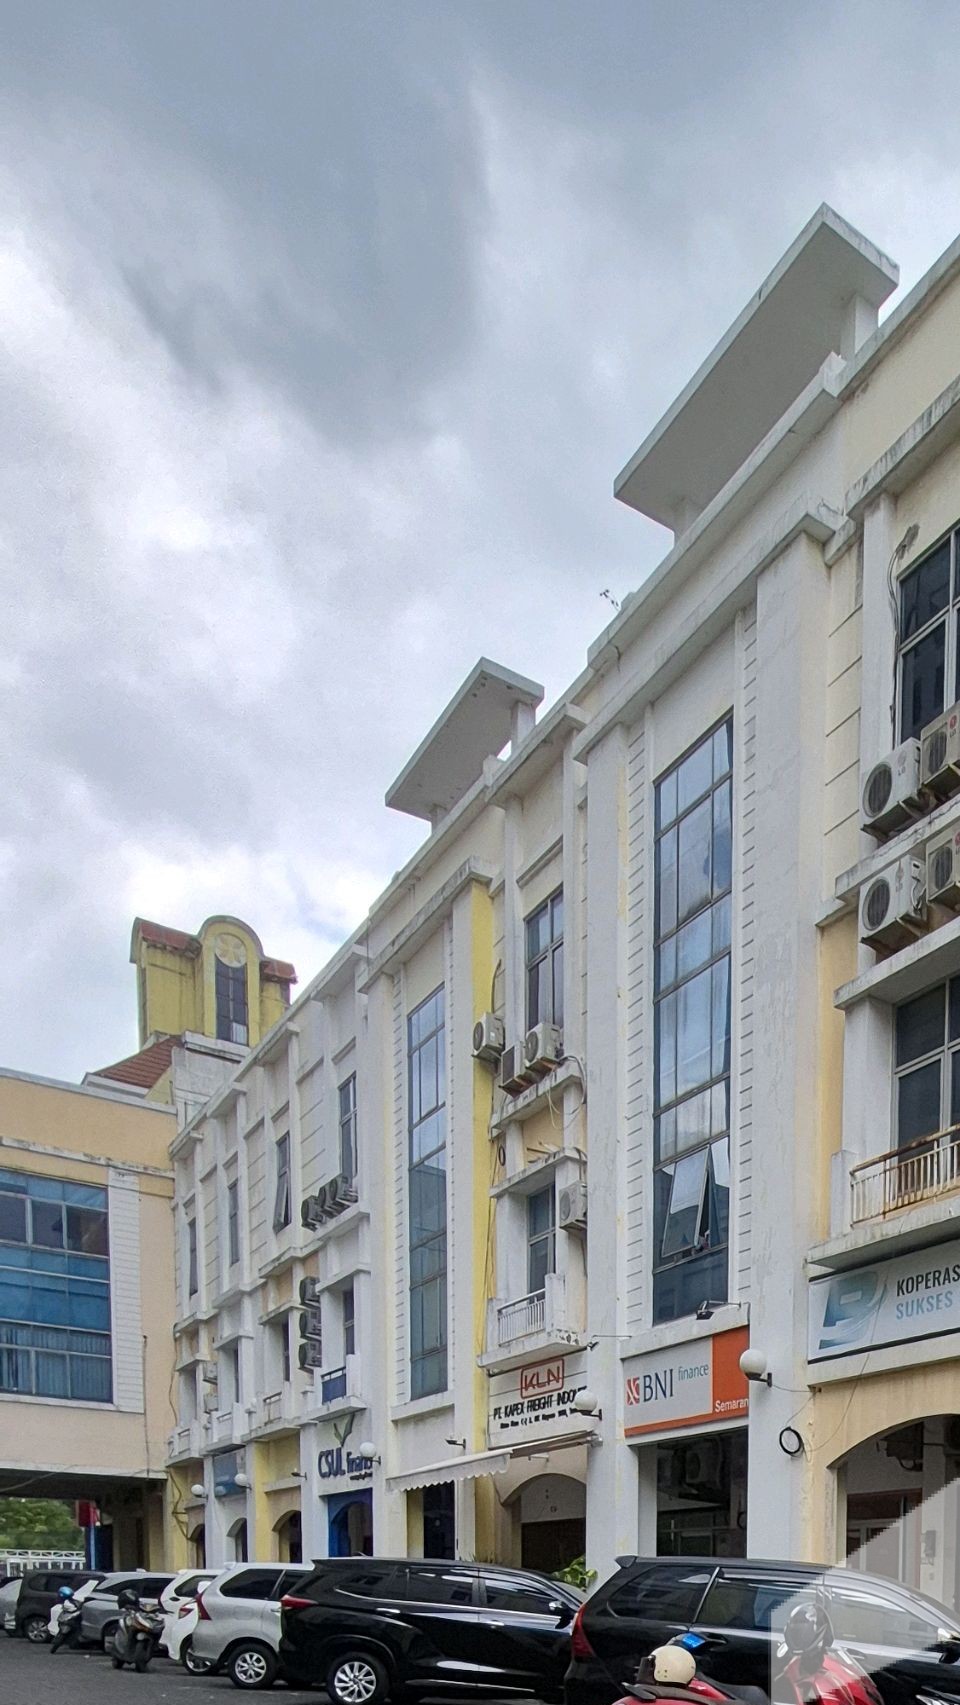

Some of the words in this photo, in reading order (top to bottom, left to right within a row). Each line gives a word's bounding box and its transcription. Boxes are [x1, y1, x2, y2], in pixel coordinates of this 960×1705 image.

[896, 1290, 953, 1320] SUKSES
[524, 1365, 561, 1392] KLN
[643, 1368, 674, 1403] BNI
[678, 1363, 710, 1382] finance
[504, 1401, 525, 1419] KAPEX
[526, 1394, 554, 1414] FREIGHT
[556, 1385, 588, 1407] INDO
[317, 1447, 346, 1479] CSUL
